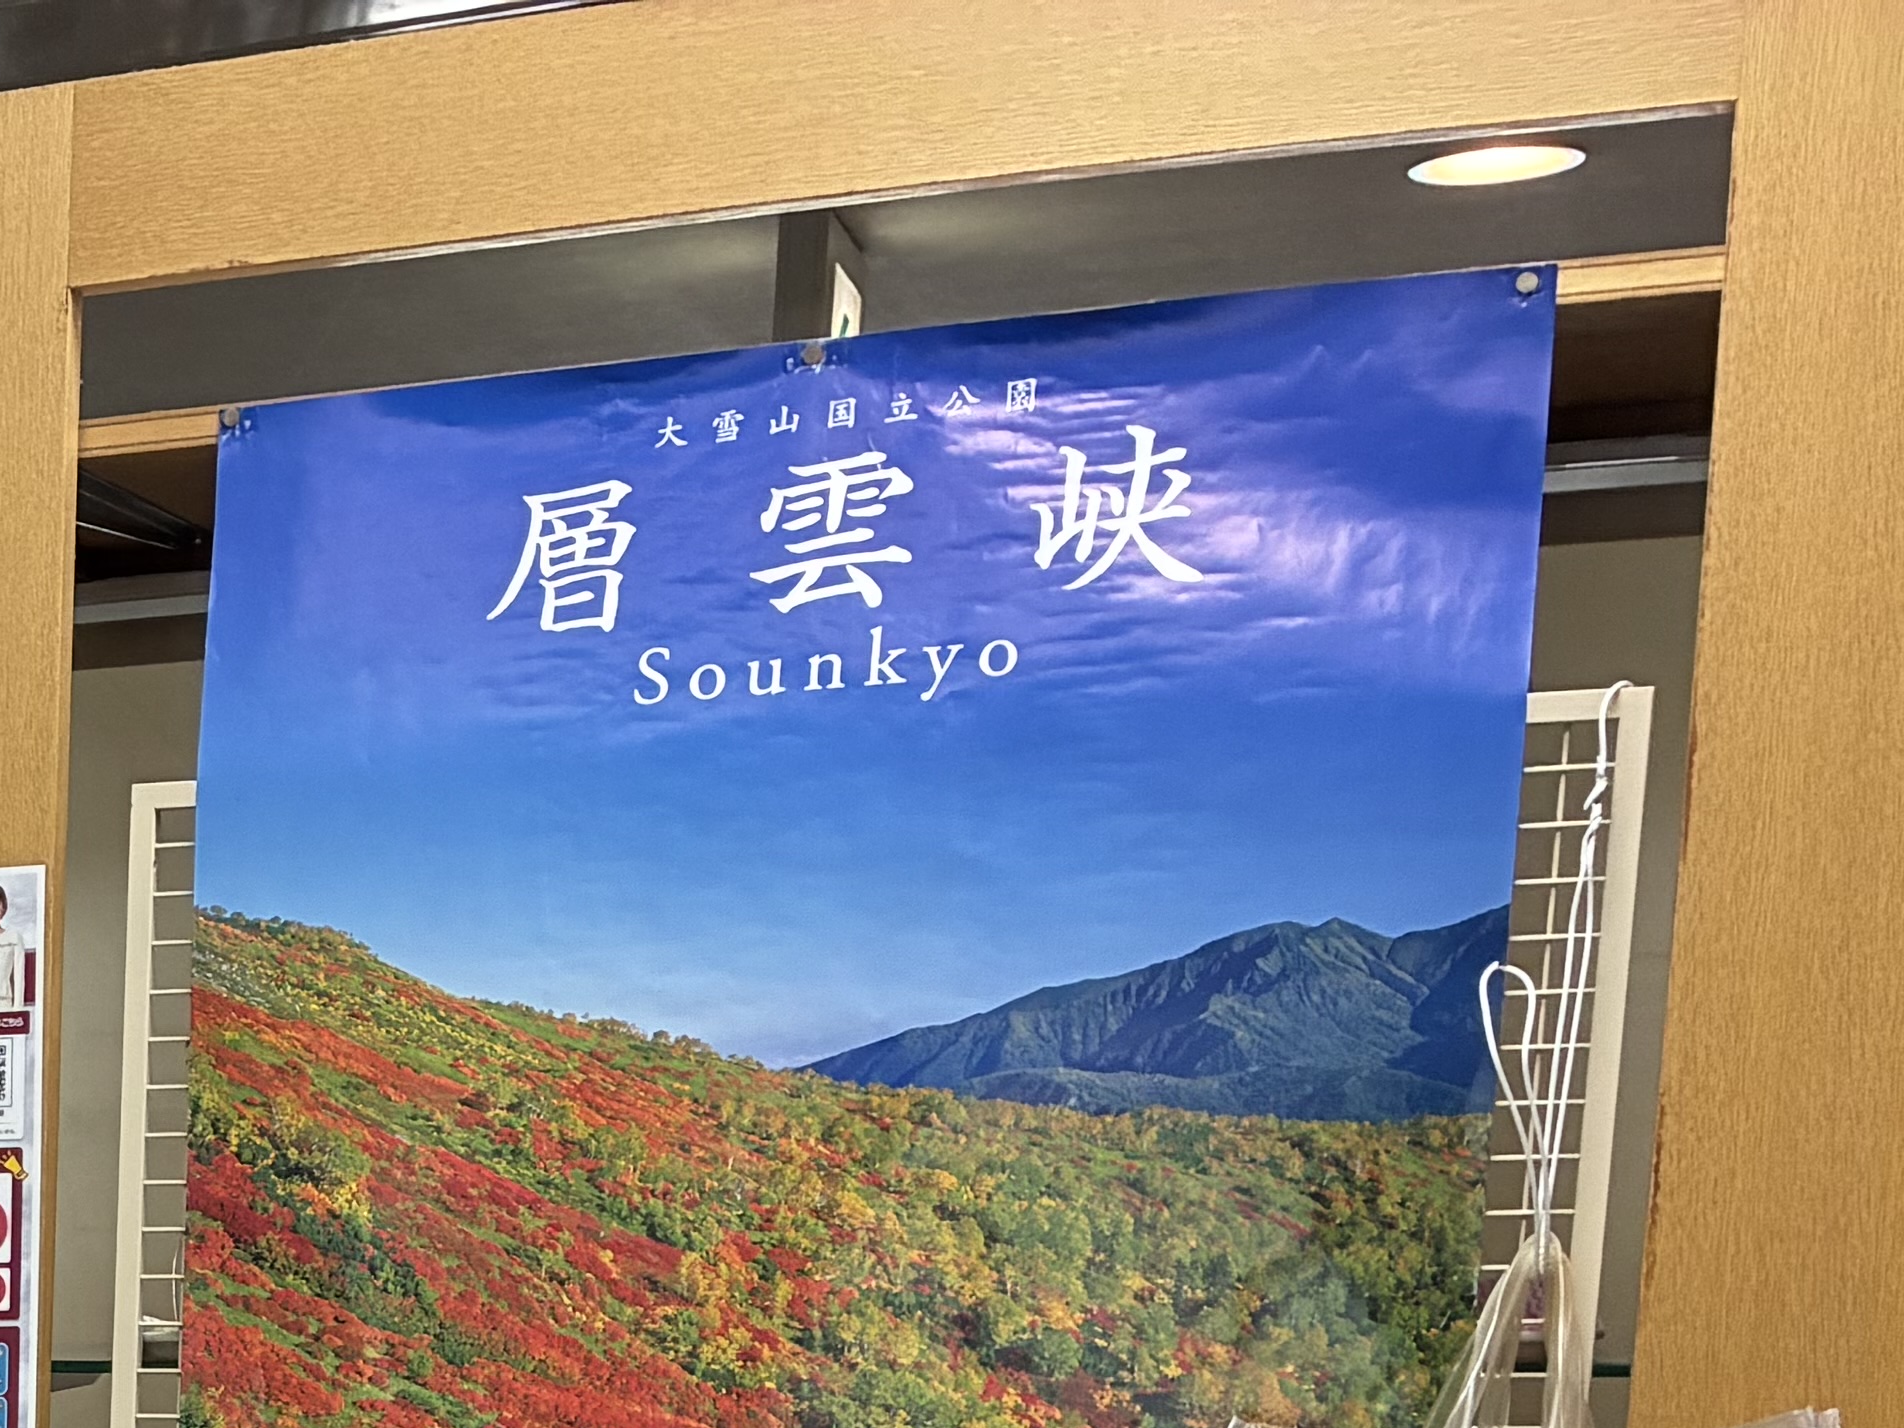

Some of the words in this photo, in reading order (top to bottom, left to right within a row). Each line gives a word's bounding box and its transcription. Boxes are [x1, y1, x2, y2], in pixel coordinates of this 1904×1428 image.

[654, 377, 1038, 448] 大雪山国立公園
[485, 423, 1205, 633] 層雲峡
[633, 626, 1019, 706] Sounkyo
